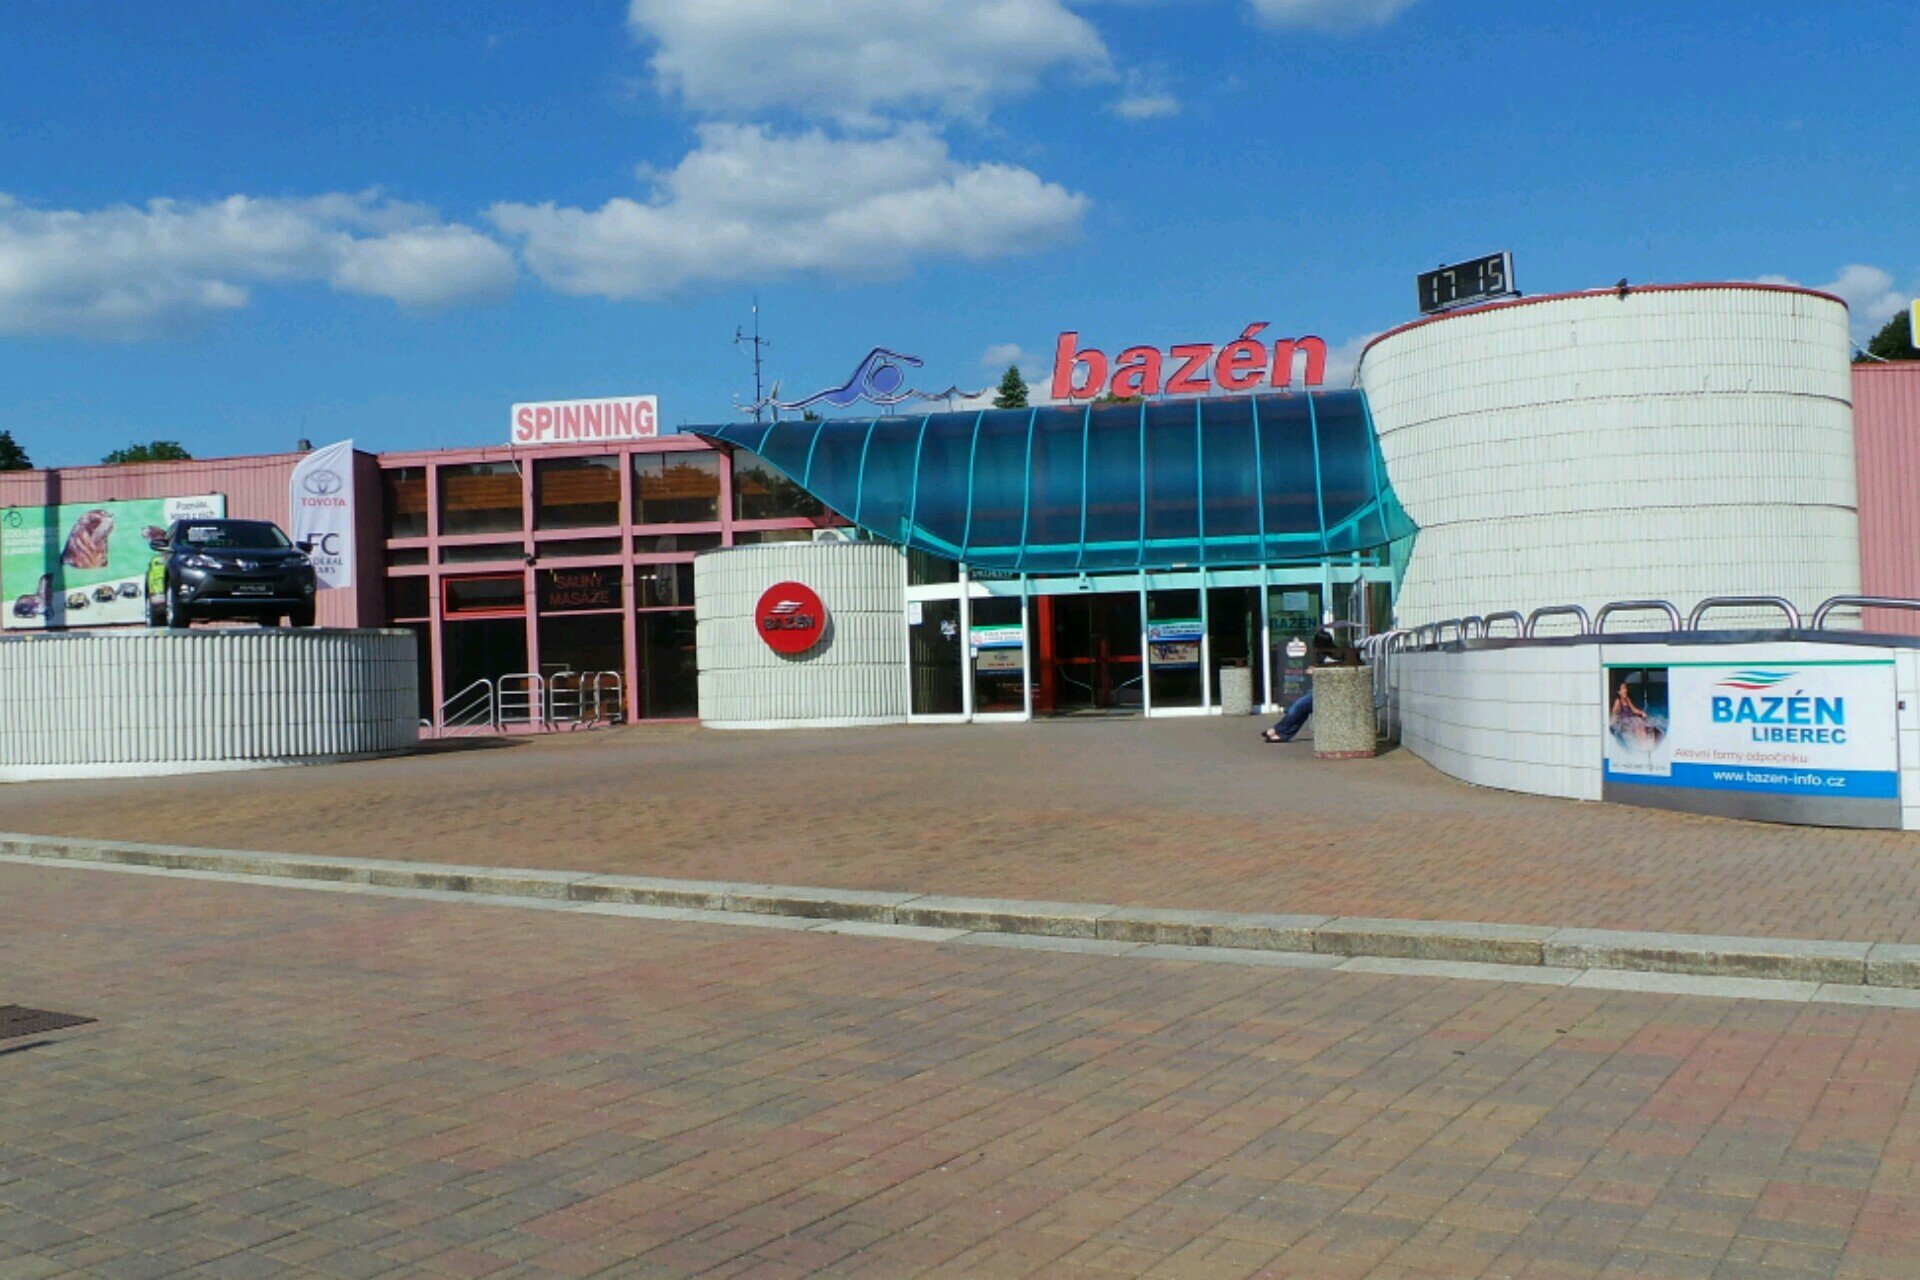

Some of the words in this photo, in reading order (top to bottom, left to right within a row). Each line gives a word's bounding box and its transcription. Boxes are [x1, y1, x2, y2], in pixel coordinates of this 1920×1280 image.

[1051, 321, 1327, 399] bazén
[516, 400, 654, 441] SPINNING
[301, 497, 346, 507] TOYOTA
[306, 532, 340, 556] FC
[1711, 689, 1845, 725] BAZÉN
[1751, 727, 1847, 744] LIBEREC
[1713, 749, 1744, 763] formy
[1746, 751, 1808, 764] odpočinku
[1713, 770, 1847, 787] www.bazen-info.cz
